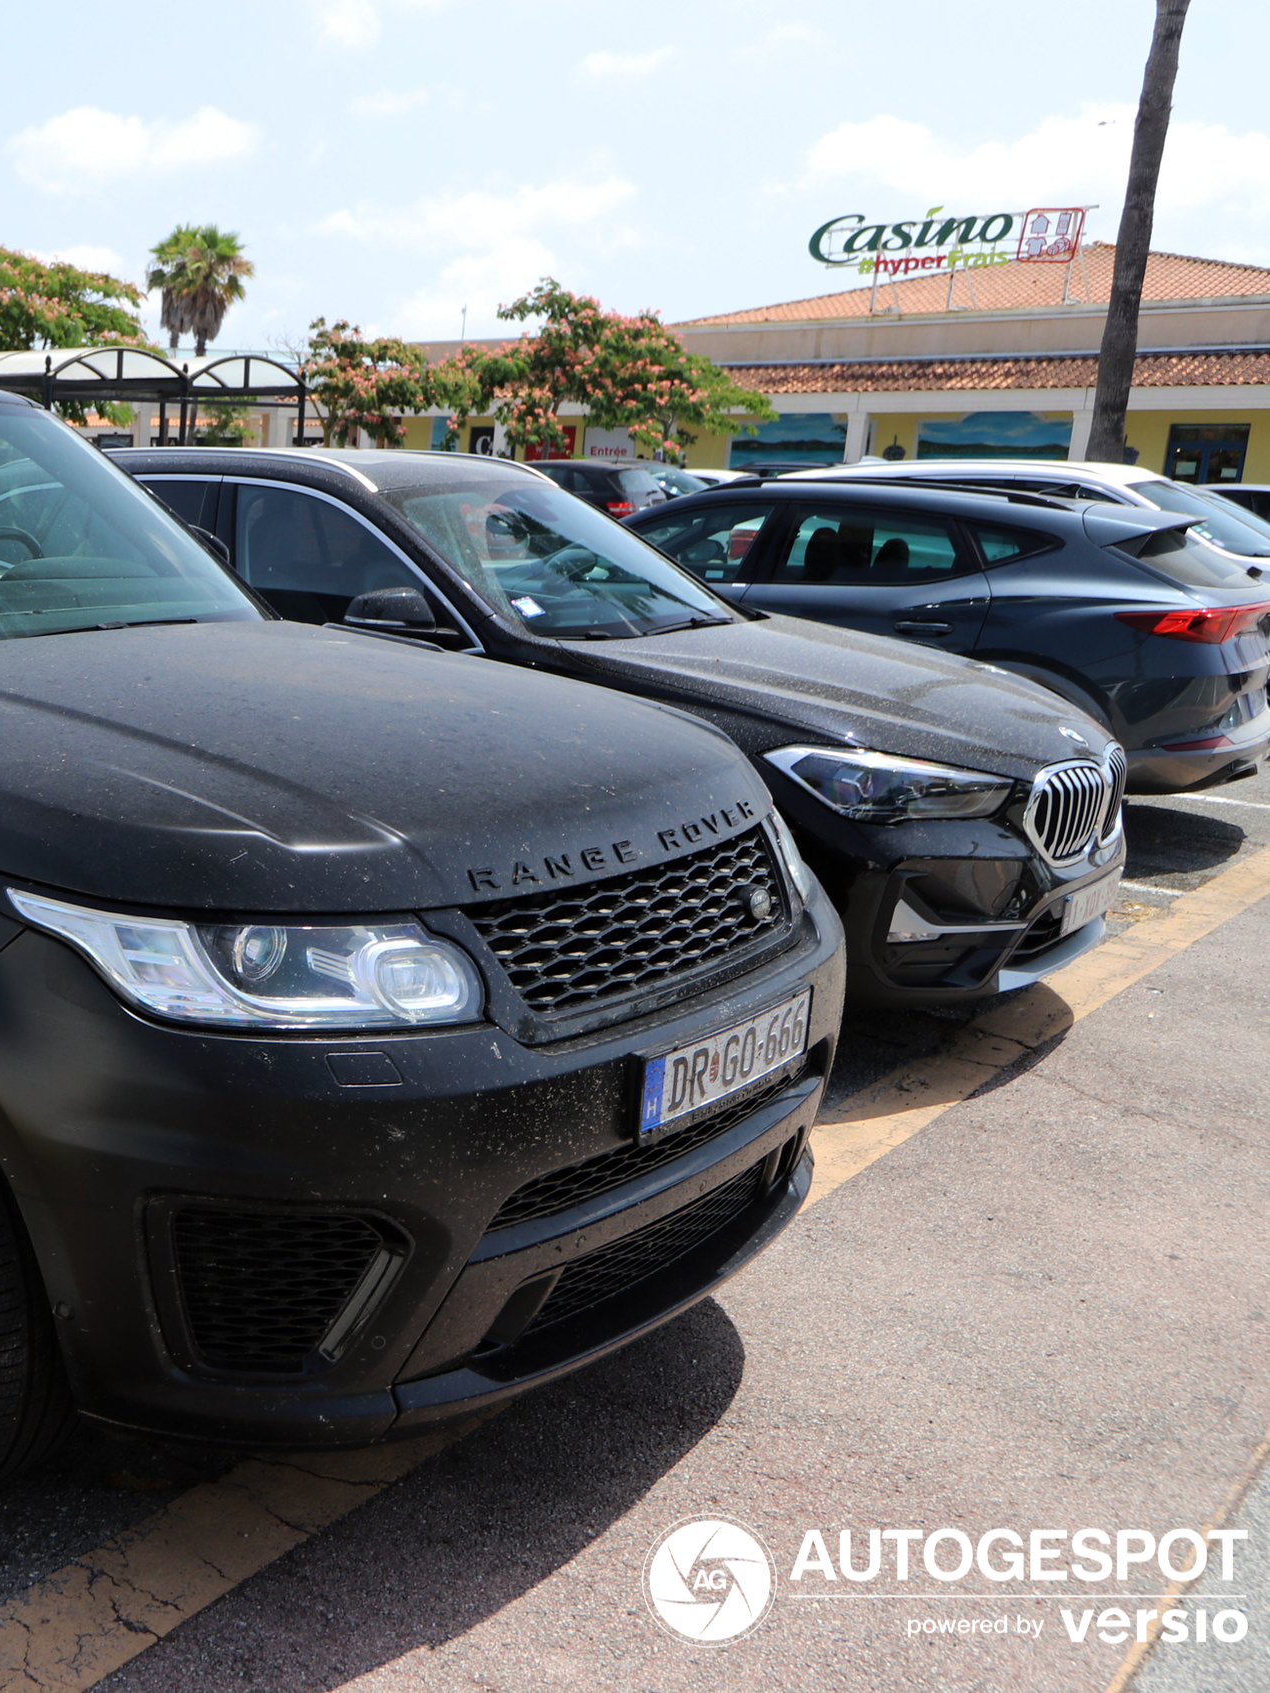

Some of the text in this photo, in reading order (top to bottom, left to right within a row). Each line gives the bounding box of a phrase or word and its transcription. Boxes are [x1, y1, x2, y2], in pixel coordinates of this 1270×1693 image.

[809, 205, 1013, 264] Casino
[857, 246, 1009, 275] #hyperFrais
[466, 800, 755, 892] RANGE ROVER
[646, 1097, 658, 1119] H
